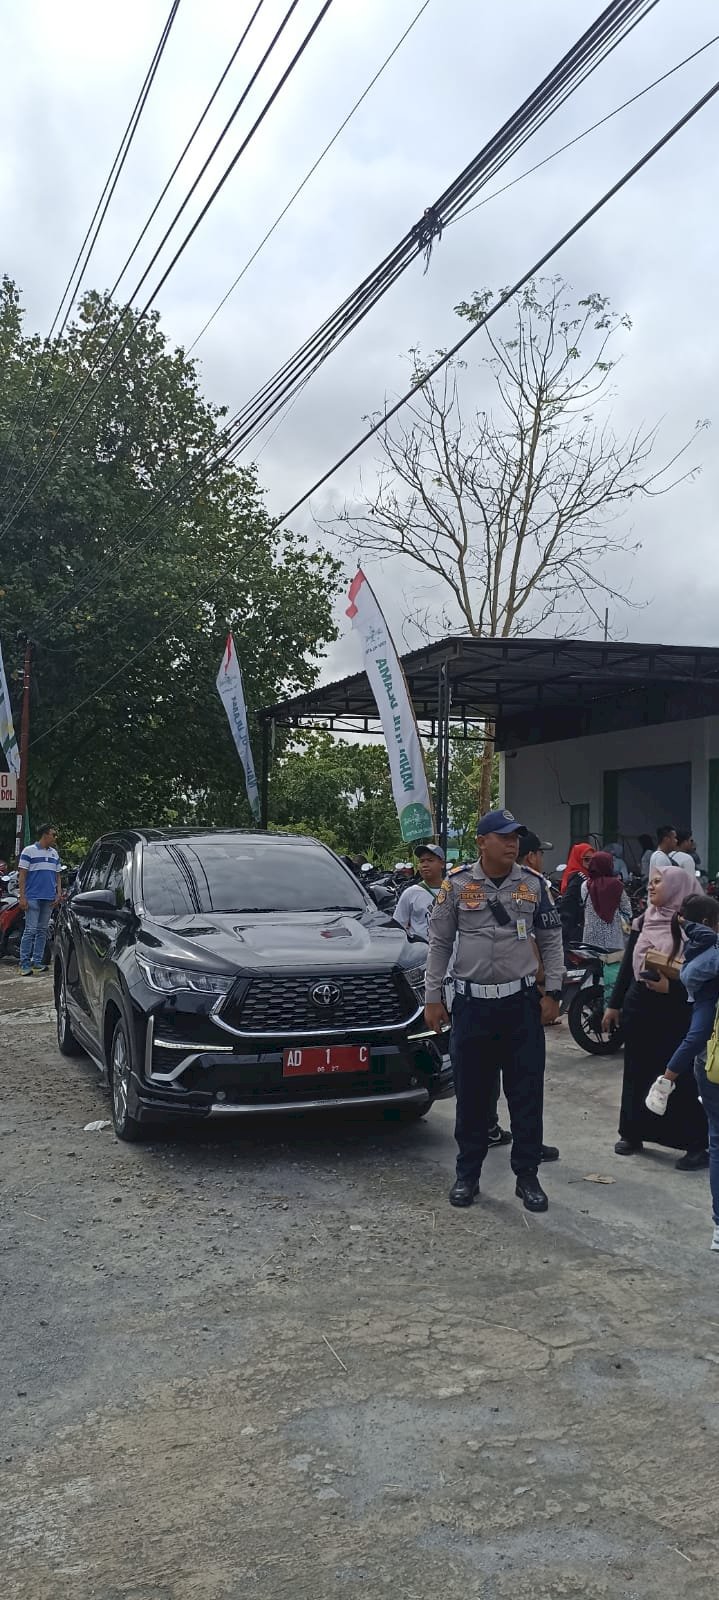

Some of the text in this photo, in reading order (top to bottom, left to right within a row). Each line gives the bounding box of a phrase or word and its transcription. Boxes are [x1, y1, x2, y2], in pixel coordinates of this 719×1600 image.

[287, 1046, 367, 1067] AD 1 C
